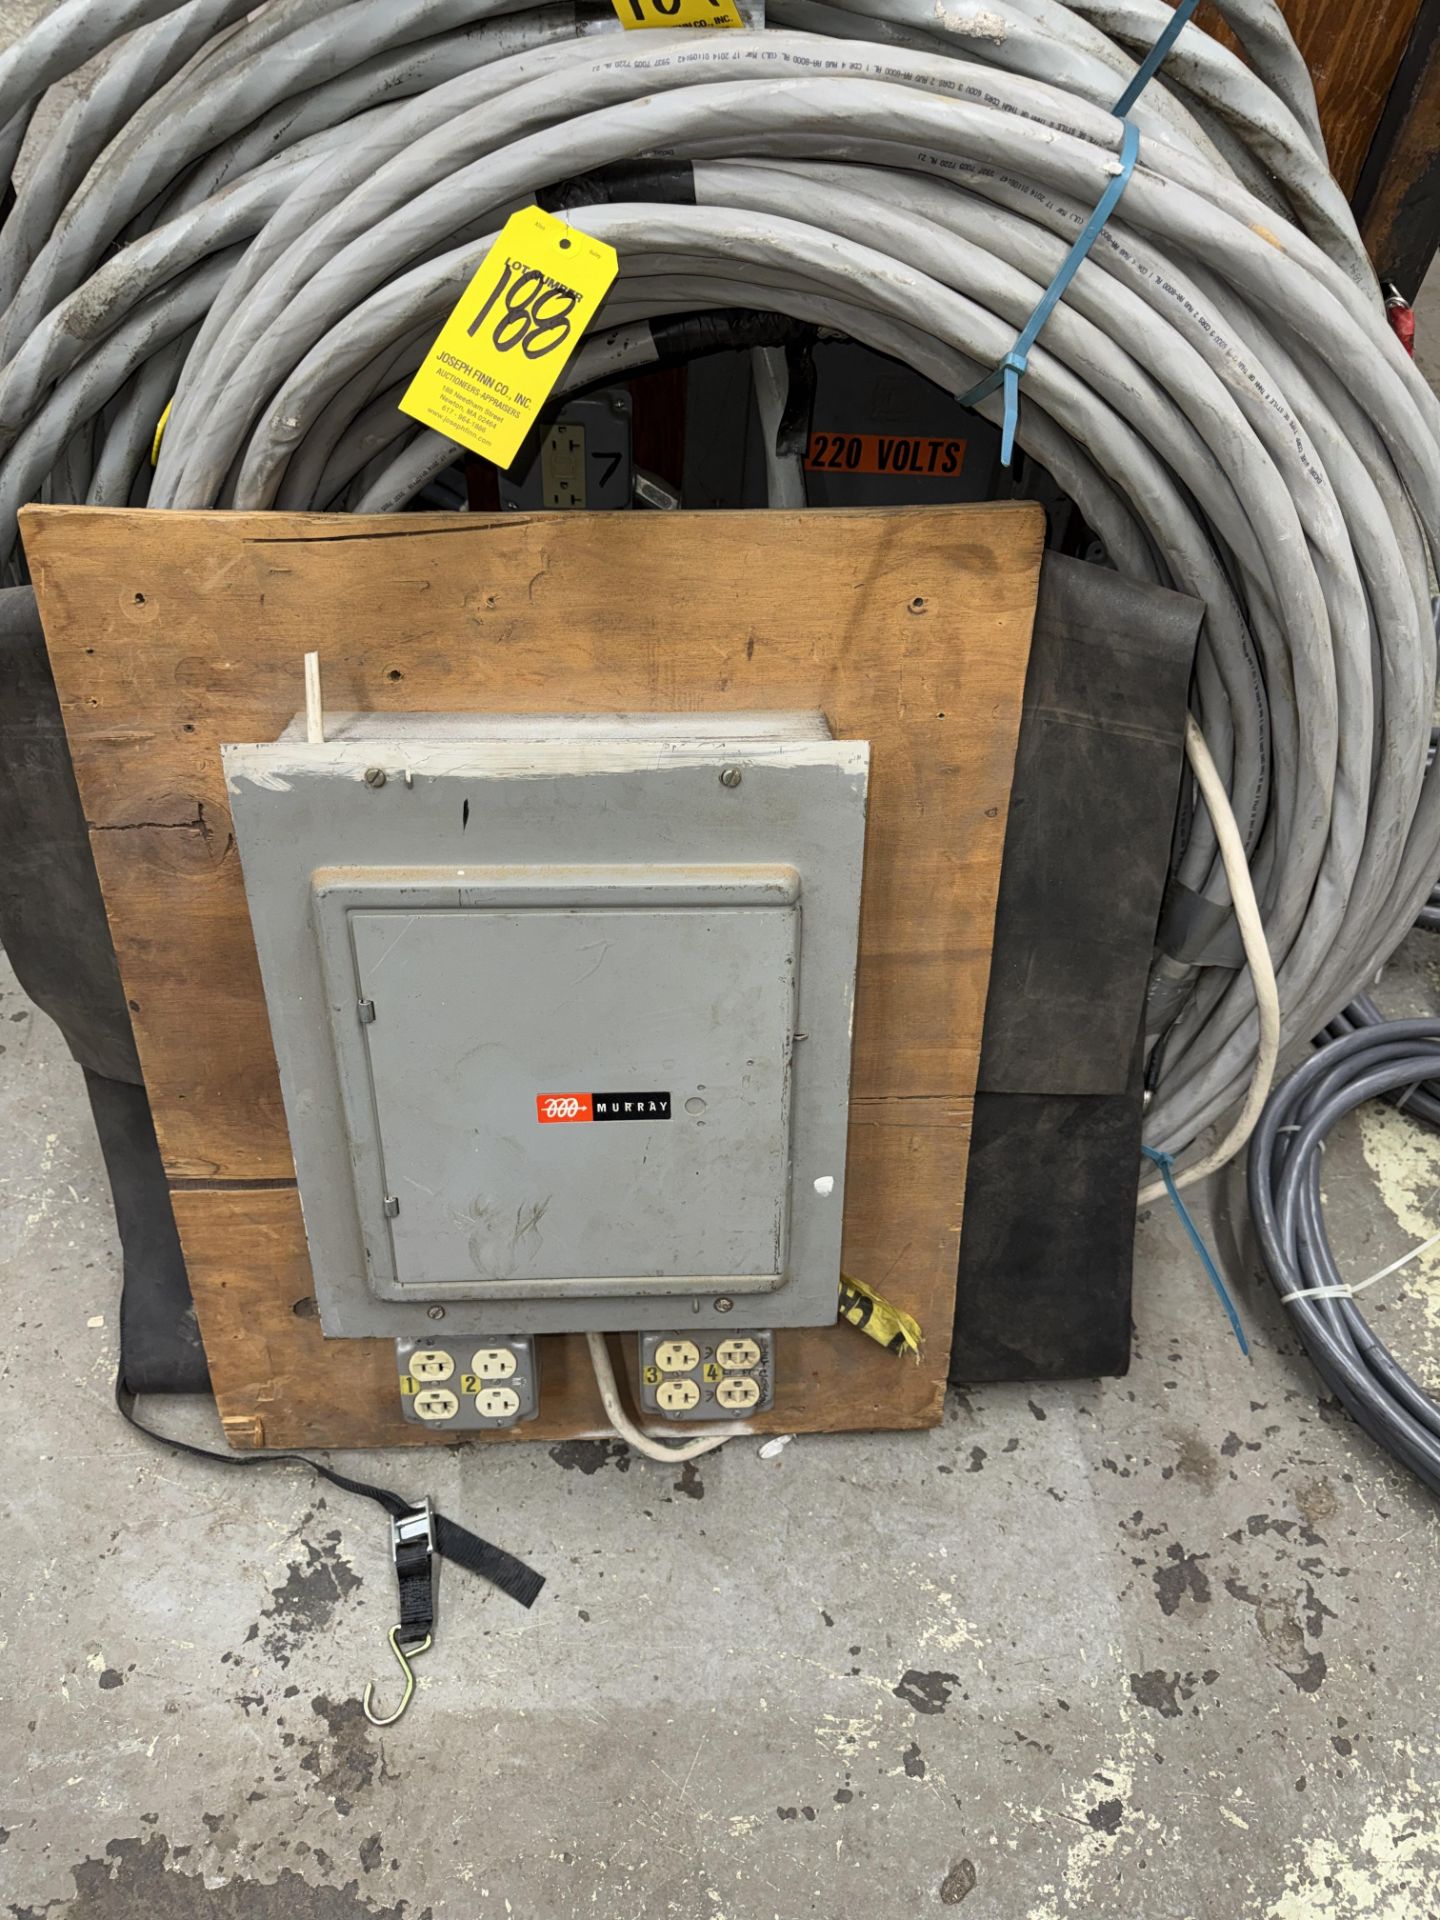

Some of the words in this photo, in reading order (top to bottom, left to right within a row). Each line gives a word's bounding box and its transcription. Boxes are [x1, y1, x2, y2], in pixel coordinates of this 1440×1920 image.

[713, 14, 734, 25] INC.
[713, 52, 729, 61] 2014
[732, 51, 740, 60] 17
[1031, 190, 1046, 203] 2014
[504, 257, 532, 274] LOT
[466, 264, 577, 360] 188
[436, 351, 474, 376] JOSEPH
[471, 369, 495, 388] FINN
[494, 381, 512, 401] CO.,
[514, 392, 533, 411] INC.
[453, 391, 484, 413] Needham
[484, 406, 504, 424] Street
[466, 409, 477, 419] MA
[811, 436, 863, 469] 220
[877, 439, 961, 473] VOLTS
[591, 452, 623, 488] 7
[596, 1101, 668, 1113] MURRAY
[647, 1367, 658, 1383] 3
[707, 1364, 718, 1381] 4
[405, 1377, 413, 1393] 1
[465, 1376, 477, 1393] 2
